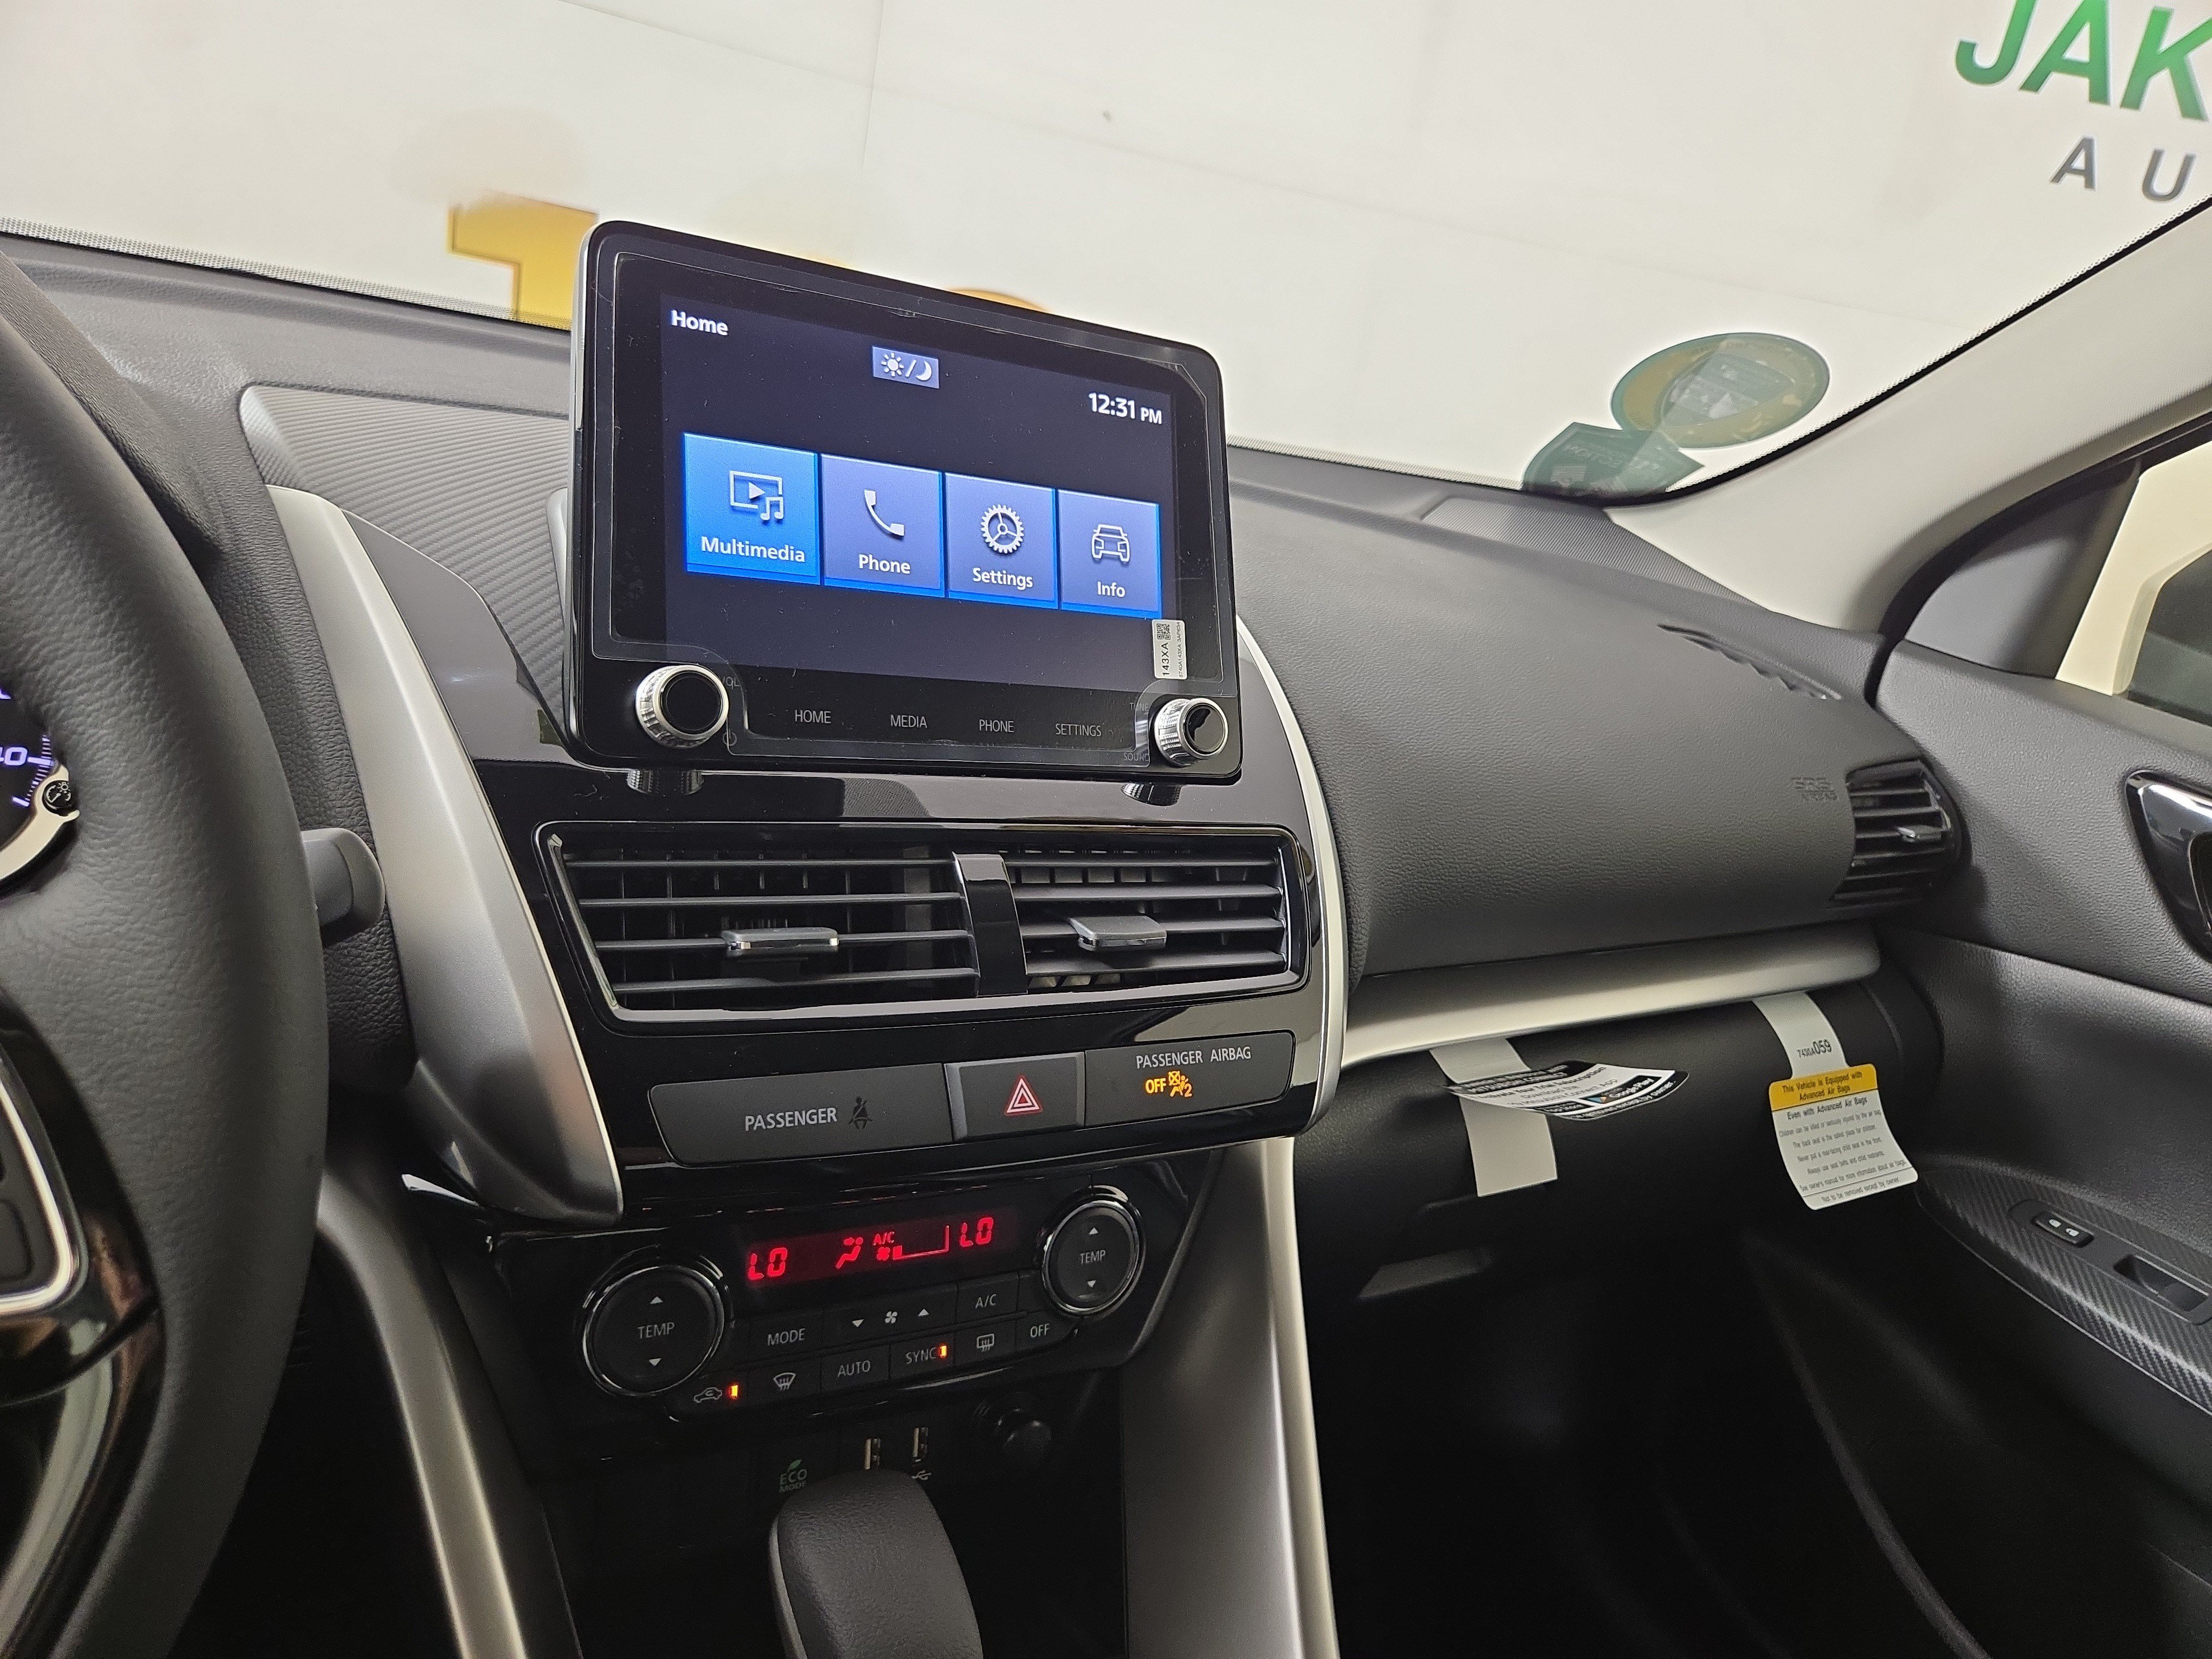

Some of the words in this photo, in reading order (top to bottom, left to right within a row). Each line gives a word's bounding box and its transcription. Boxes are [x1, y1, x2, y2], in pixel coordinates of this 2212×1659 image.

[672, 310, 728, 336] Home
[1089, 393, 1135, 419] 12:31
[1141, 407, 1162, 424] PM
[702, 536, 805, 562] Multimedia
[859, 554, 910, 574] Phone
[973, 568, 1033, 590] Settings
[1097, 581, 1126, 597] Info
[1161, 642, 1170, 676] 143XA
[722, 676, 741, 690] OL
[795, 710, 831, 724] HOME
[1129, 703, 1149, 715] TUNE
[890, 715, 927, 728] MEDIA
[979, 719, 1014, 732] PHONE
[1056, 723, 1102, 737] SETTINGS
[1123, 752, 1149, 762] SOUND
[1136, 1050, 1203, 1069] PASSENGER
[1210, 1046, 1251, 1062] AIRBAG
[1145, 1077, 1167, 1094] OFF
[745, 1107, 837, 1131] PASSENGER
[873, 1232, 894, 1245] A/C
[1080, 1250, 1106, 1264] TEMP
[975, 1294, 996, 1309] A/C
[638, 1322, 675, 1339] TEMP
[768, 1328, 805, 1346] MODE
[1030, 1323, 1049, 1338] OFF
[905, 1347, 936, 1364] SYNC
[838, 1360, 871, 1377] AUTO
[780, 1469, 807, 1486] ECO
